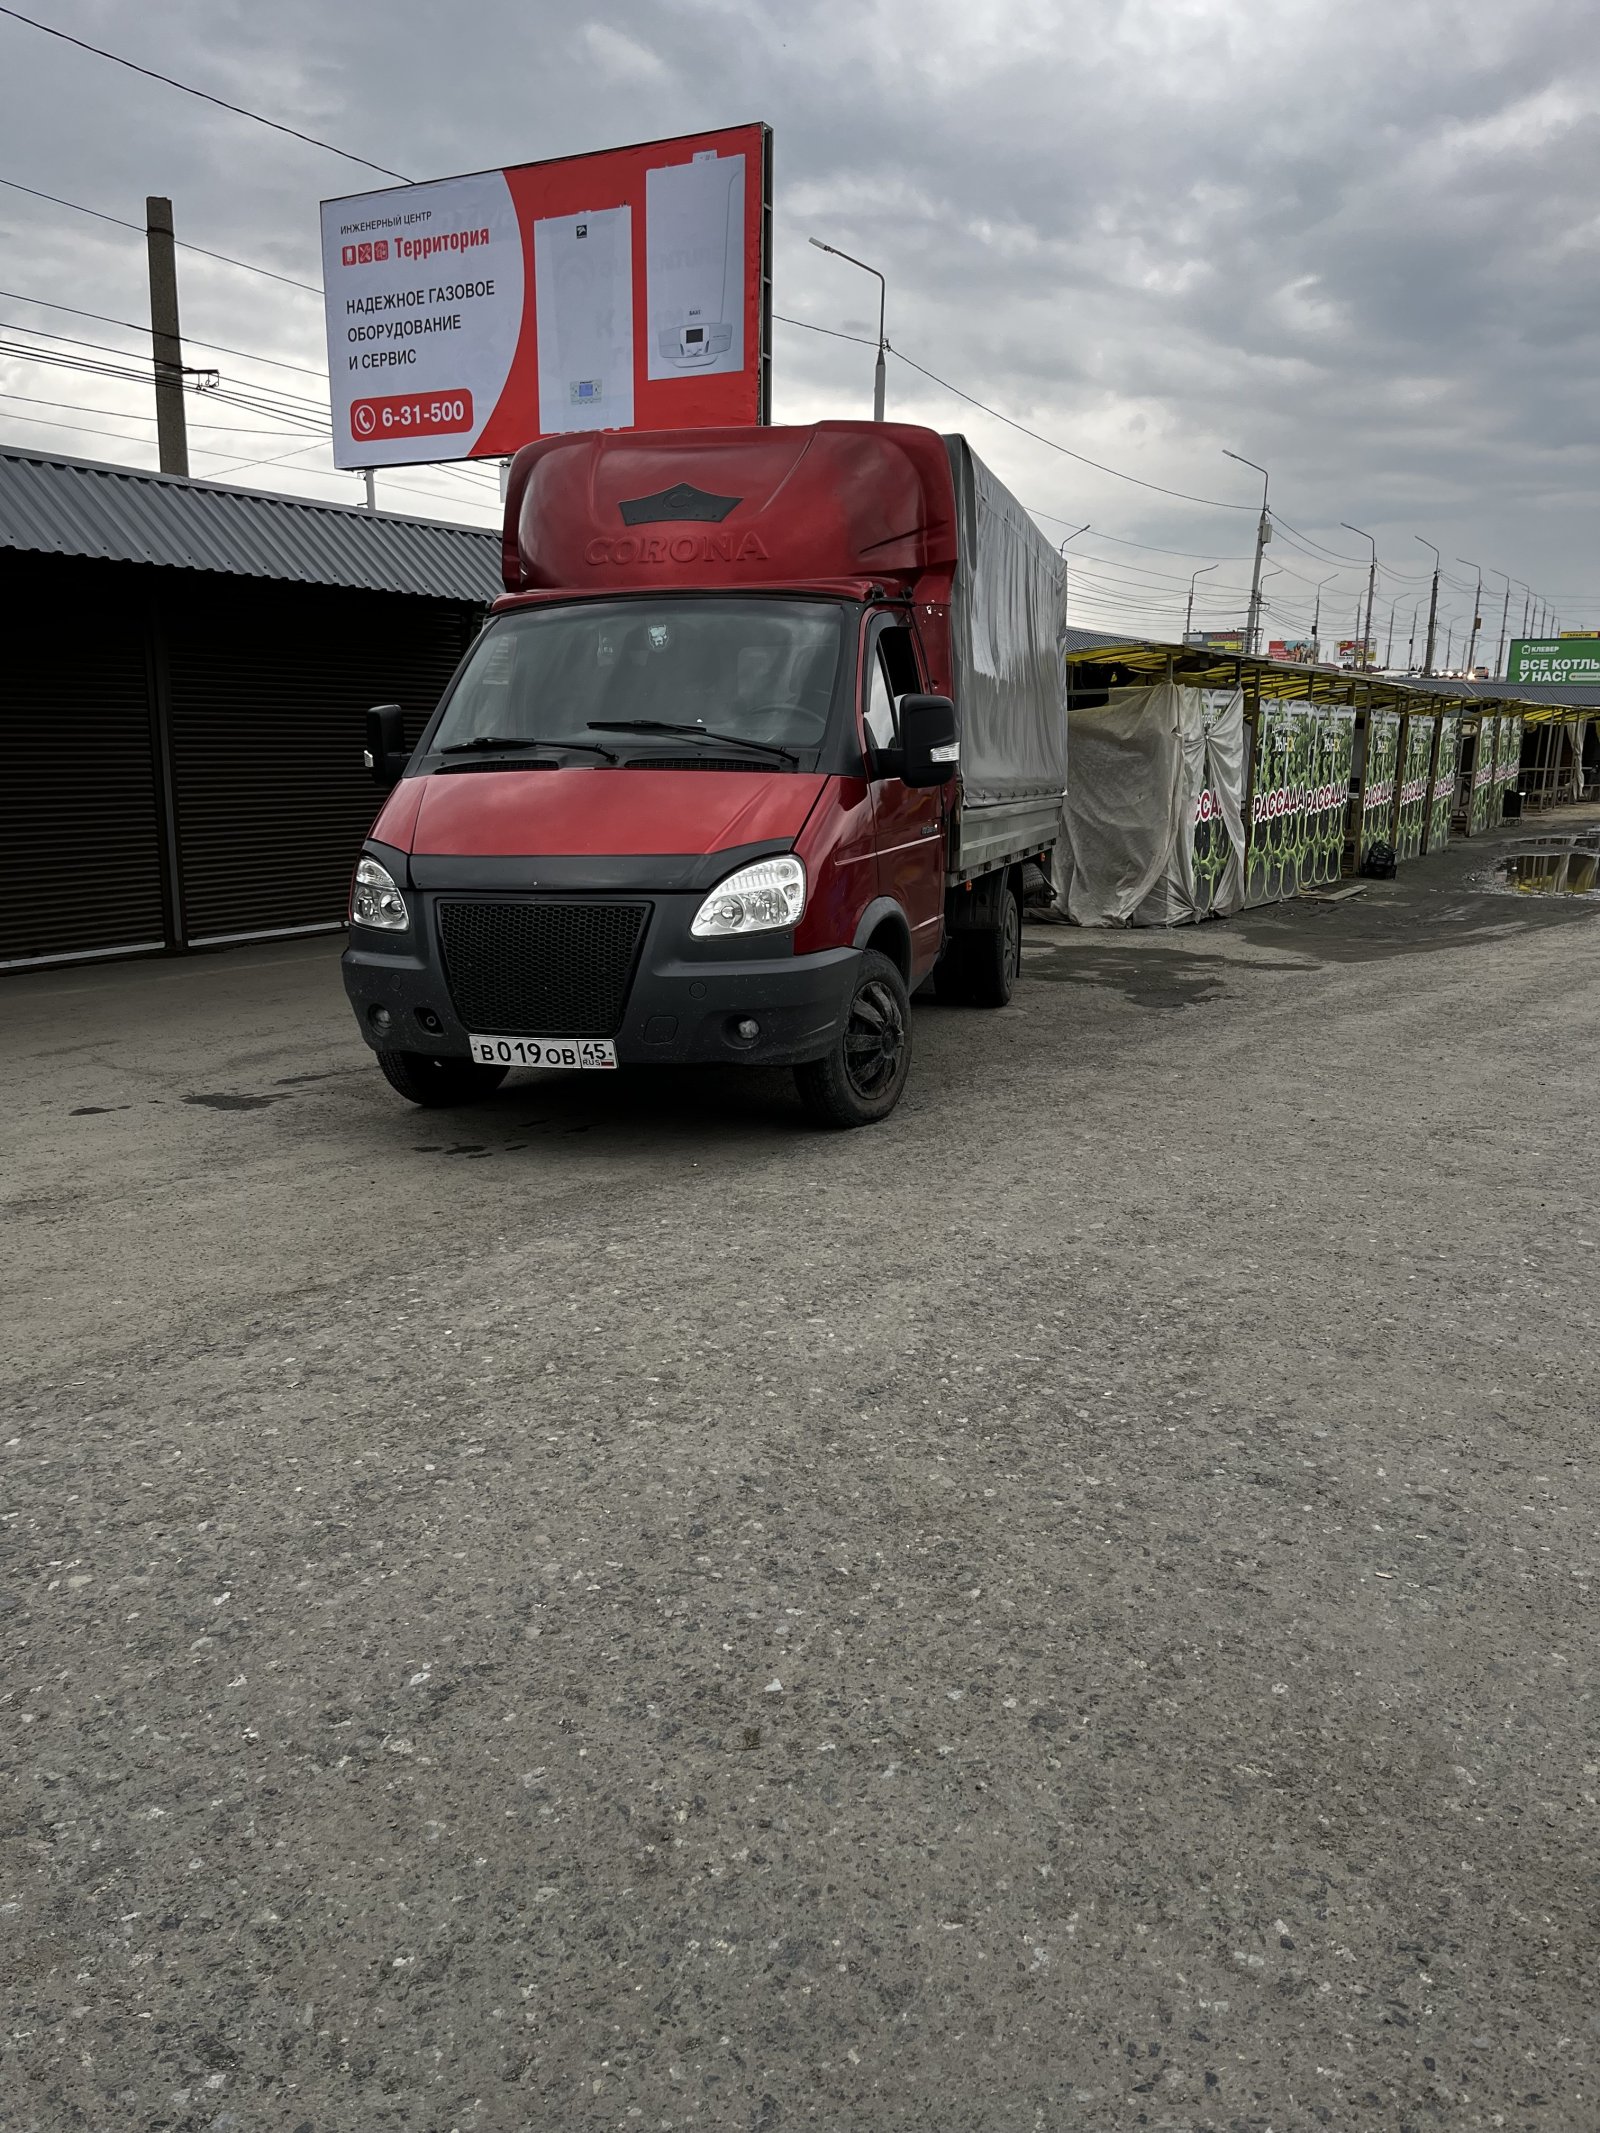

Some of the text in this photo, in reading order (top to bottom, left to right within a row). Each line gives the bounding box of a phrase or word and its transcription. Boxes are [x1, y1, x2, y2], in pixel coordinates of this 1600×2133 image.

[340, 211, 432, 235] ИНЖЕНЕРНЫЙ ЦЕНТР
[394, 228, 490, 261] Территория
[346, 280, 495, 315] НАДЕЖНОЕ ГАЗОВОЕ
[347, 314, 462, 342] ОБОРУДОВАНИЕ
[349, 349, 417, 370] И СЕРВИС
[381, 400, 464, 427] 6-31-500
[584, 530, 770, 566] CORONA
[1519, 659, 1549, 670] ВСЕ
[1519, 671, 1530, 682] У
[1531, 671, 1567, 682] НАС!
[1253, 782, 1305, 824] РАССАДА
[1305, 778, 1349, 816] РАССАДА
[480, 1041, 577, 1065] В019ОВ
